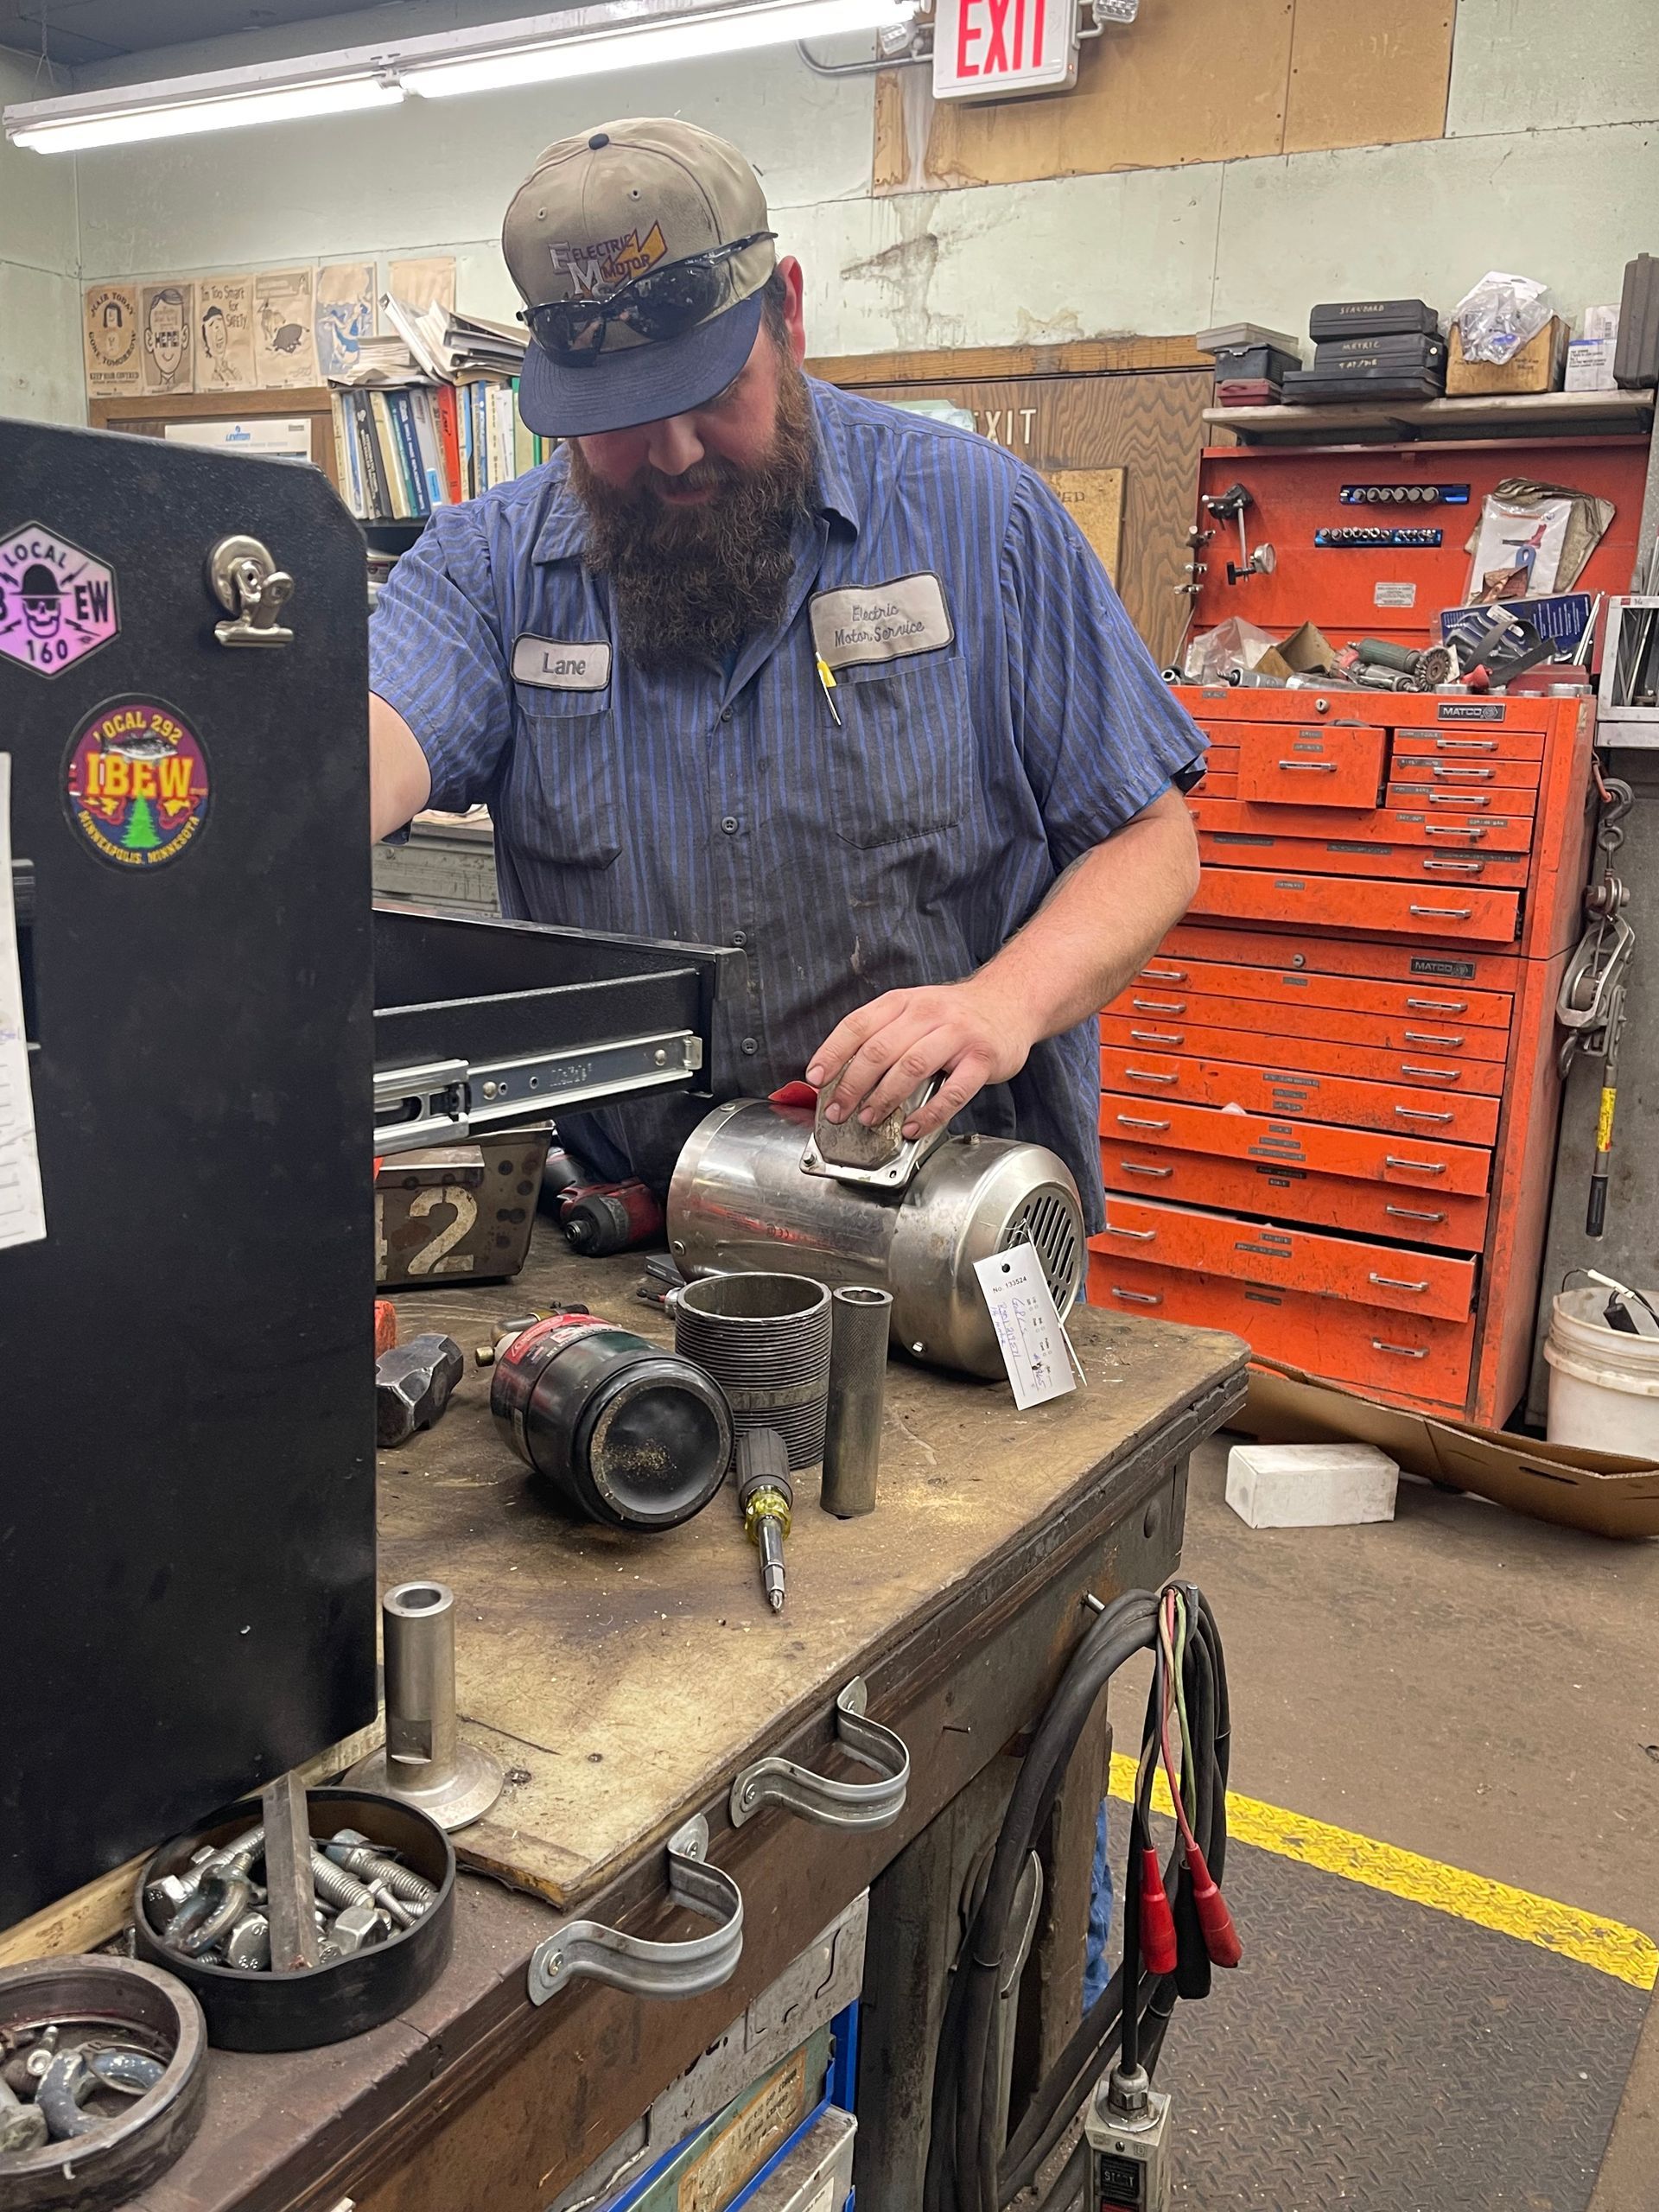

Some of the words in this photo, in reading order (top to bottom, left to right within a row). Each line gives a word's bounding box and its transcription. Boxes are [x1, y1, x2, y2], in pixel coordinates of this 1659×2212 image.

[572, 234, 633, 262] ELECTRIC
[603, 254, 650, 278] MOTOR
[974, 409, 1036, 445] XIT
[3, 541, 67, 569] LOCAL
[852, 604, 899, 622] Electric
[874, 621, 925, 643] Service
[27, 639, 68, 664] 160
[543, 652, 587, 675] Lane
[1443, 707, 1482, 716] MATCO
[150, 715, 183, 745] 292
[86, 752, 194, 798] IBEW
[147, 815, 200, 863] MINNESOTA
[1414, 961, 1453, 973] MATCO
[1005, 1275, 1027, 1288] 133524
[1104, 2171, 1134, 2187] STT
